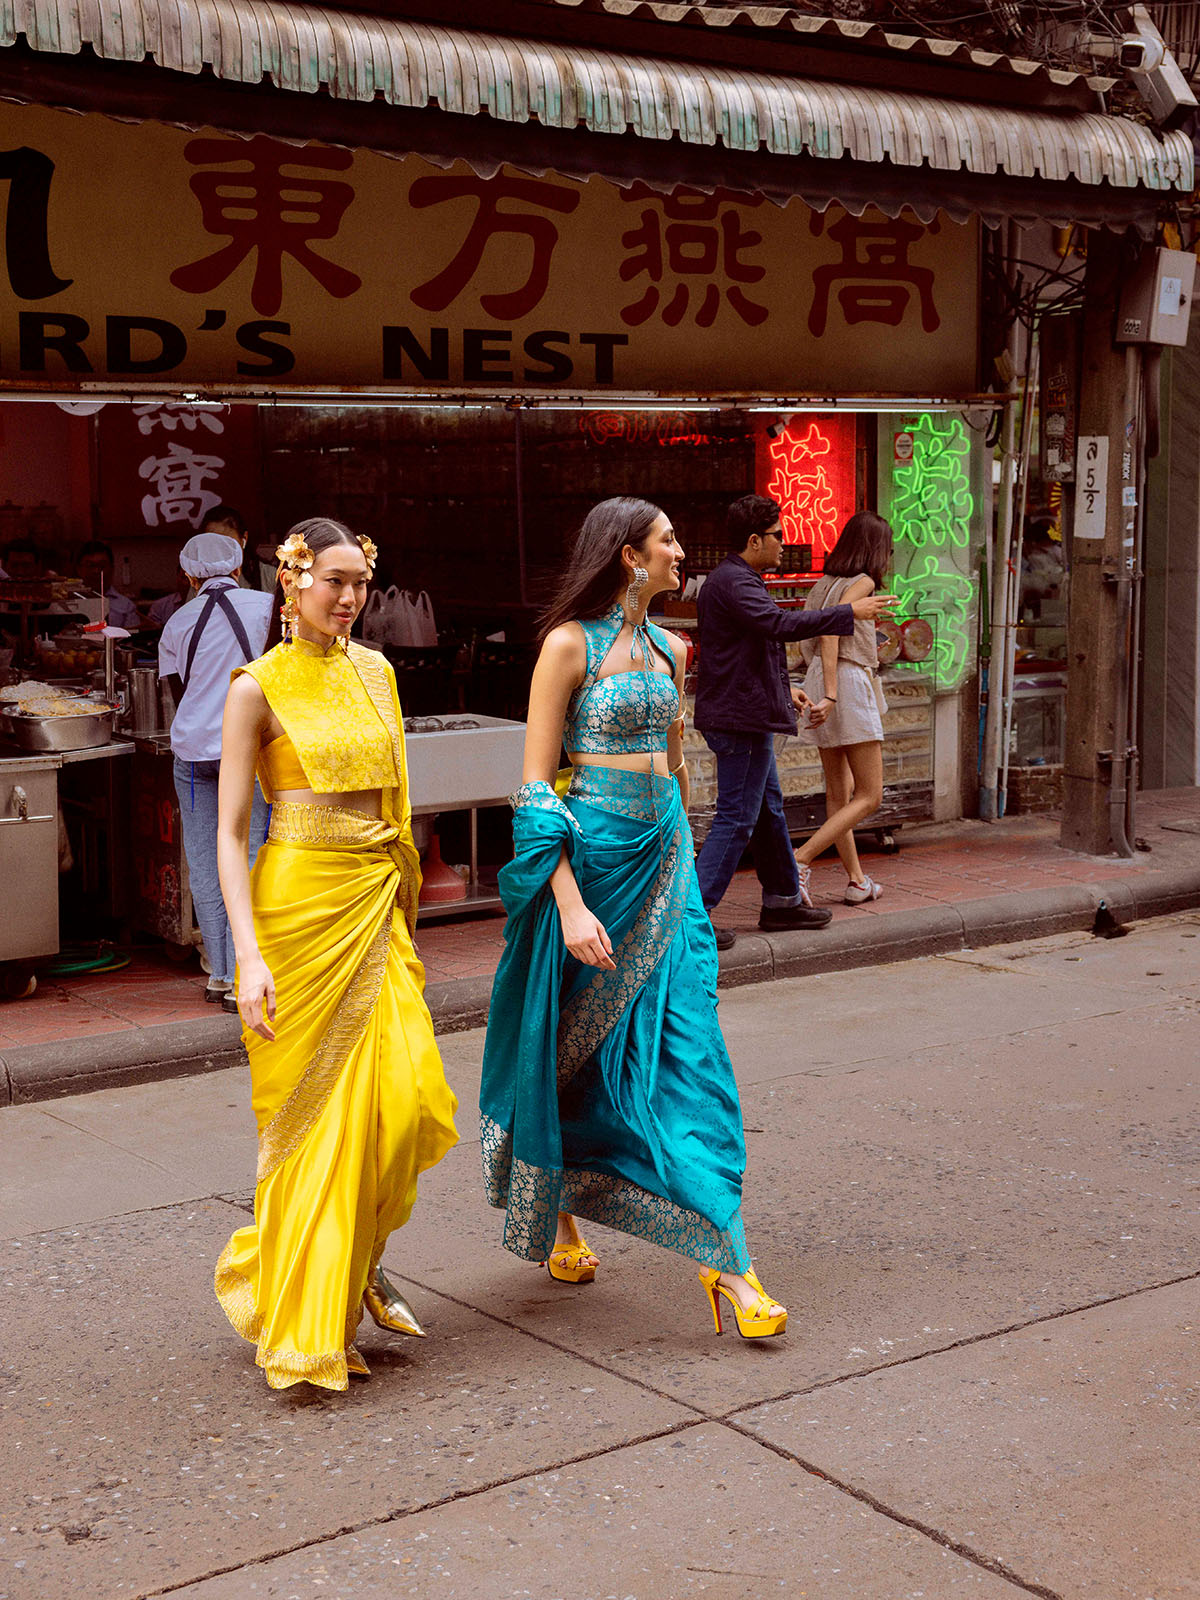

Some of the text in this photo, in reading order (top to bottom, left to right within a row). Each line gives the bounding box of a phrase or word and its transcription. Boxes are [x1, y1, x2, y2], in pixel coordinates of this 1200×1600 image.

[169, 138, 940, 337] 東方燕窩
[0, 310, 629, 384] RD'S NEST
[1087, 468, 1095, 488] 5
